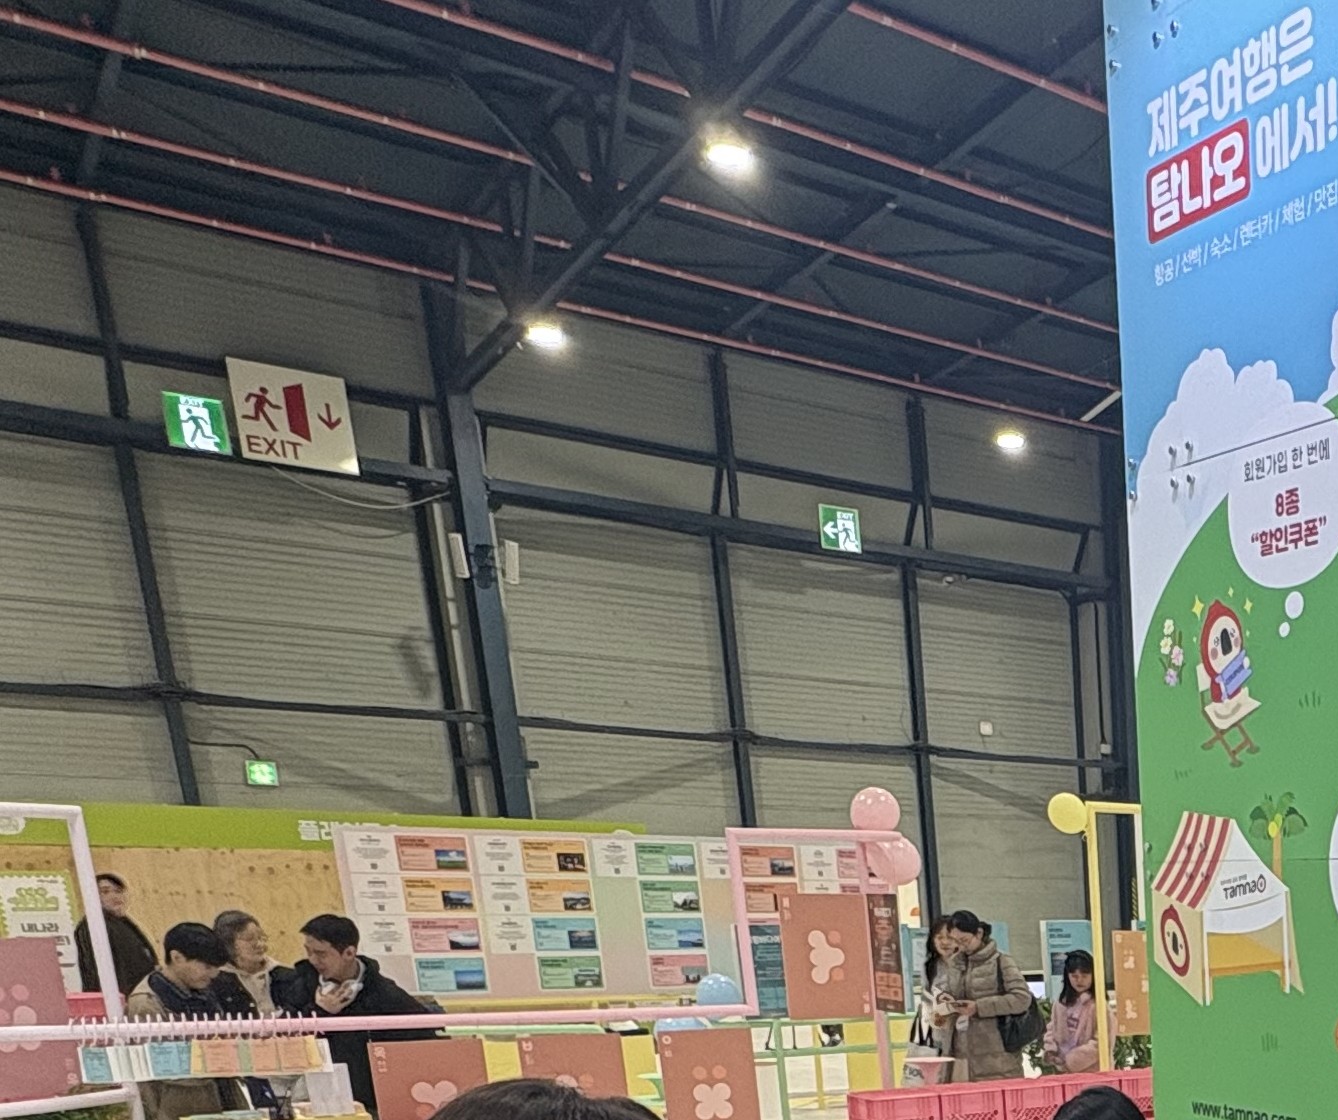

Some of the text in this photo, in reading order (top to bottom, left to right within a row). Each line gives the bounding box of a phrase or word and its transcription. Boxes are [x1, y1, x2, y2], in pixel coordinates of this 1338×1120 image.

[1146, 6, 1314, 158] 제주여행은
[1151, 131, 1246, 233] 탐나오
[1255, 77, 1338, 178] 에서!
[245, 434, 303, 460] EXIT
[1244, 437, 1331, 482] 회원가입 한 번에
[1275, 487, 1300, 517] 8종
